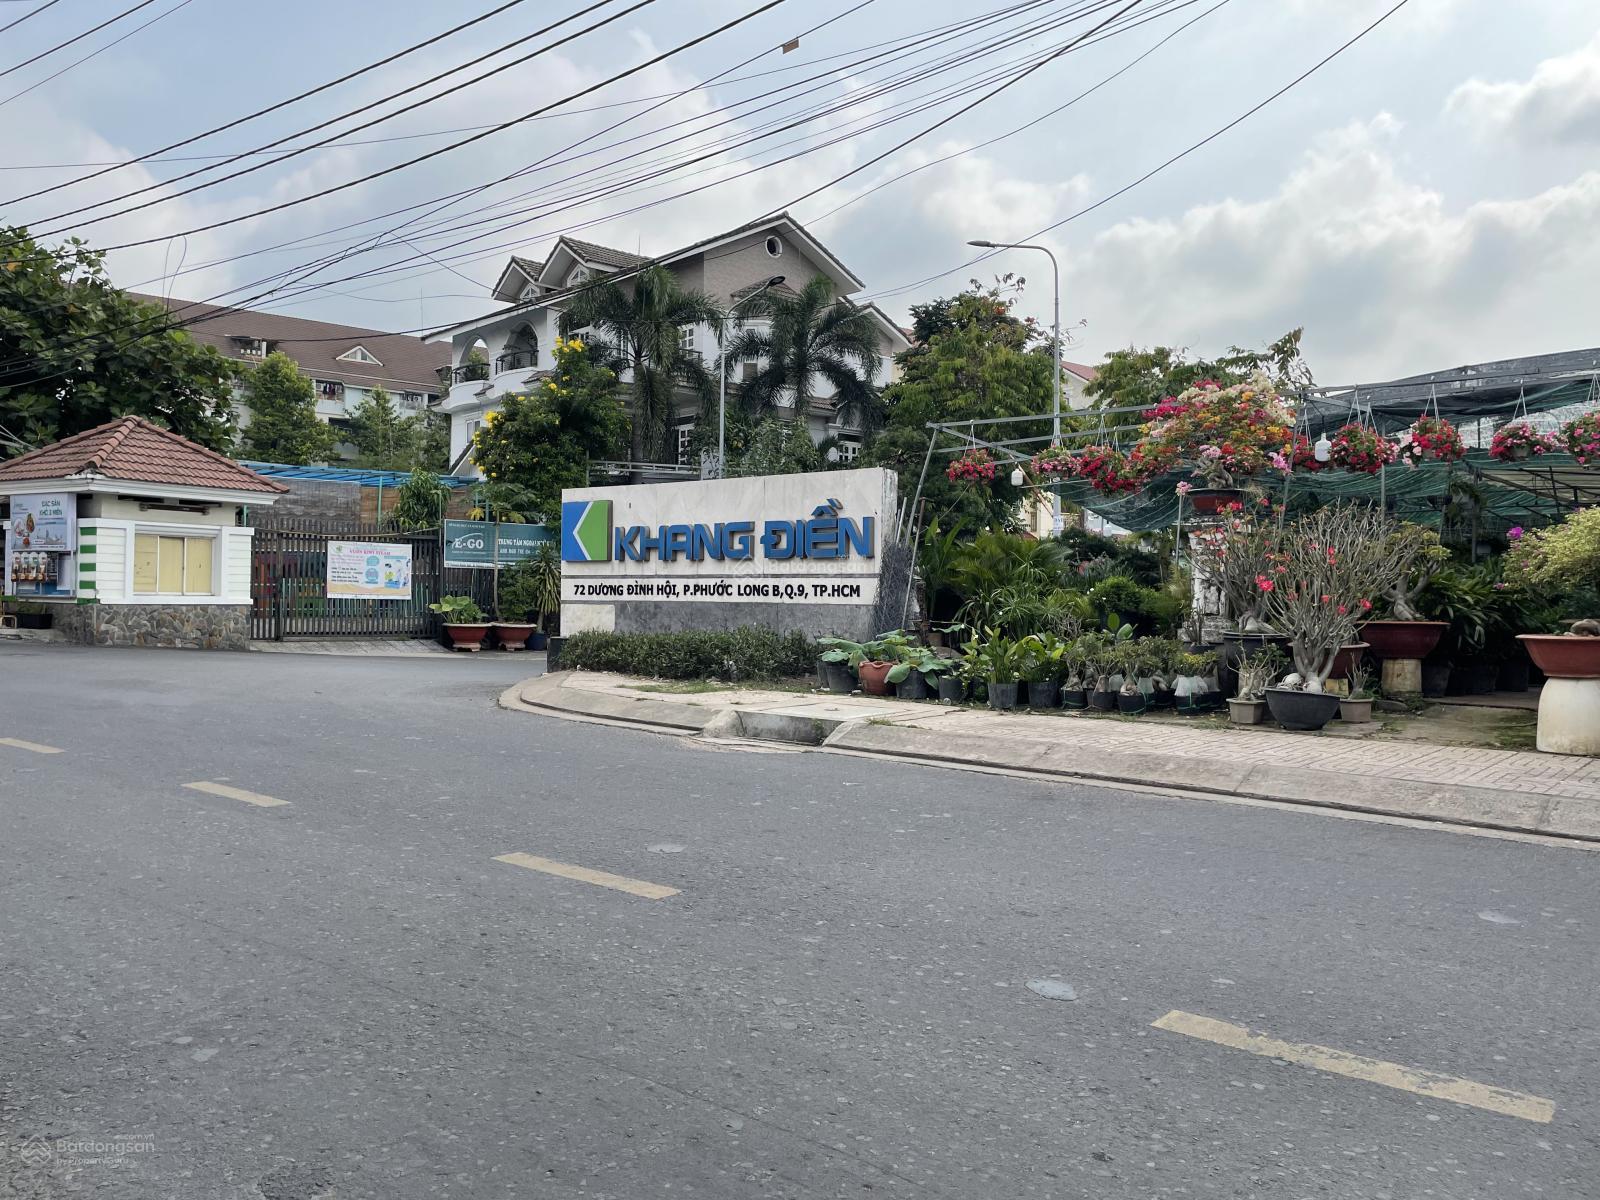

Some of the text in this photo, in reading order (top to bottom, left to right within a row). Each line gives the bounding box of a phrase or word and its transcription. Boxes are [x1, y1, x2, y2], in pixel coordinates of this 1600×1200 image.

[615, 498, 875, 561] KHANG ĐIỀN
[454, 537, 484, 549] E-GO
[574, 585, 586, 596] 72
[588, 583, 624, 597] DƯƠNG
[627, 581, 654, 596] ĐÌNH
[657, 579, 680, 599] HỘI,
[684, 580, 733, 597] P.PHƯỚC
[738, 584, 770, 597] LONG
[812, 584, 861, 597] TP.HCM
